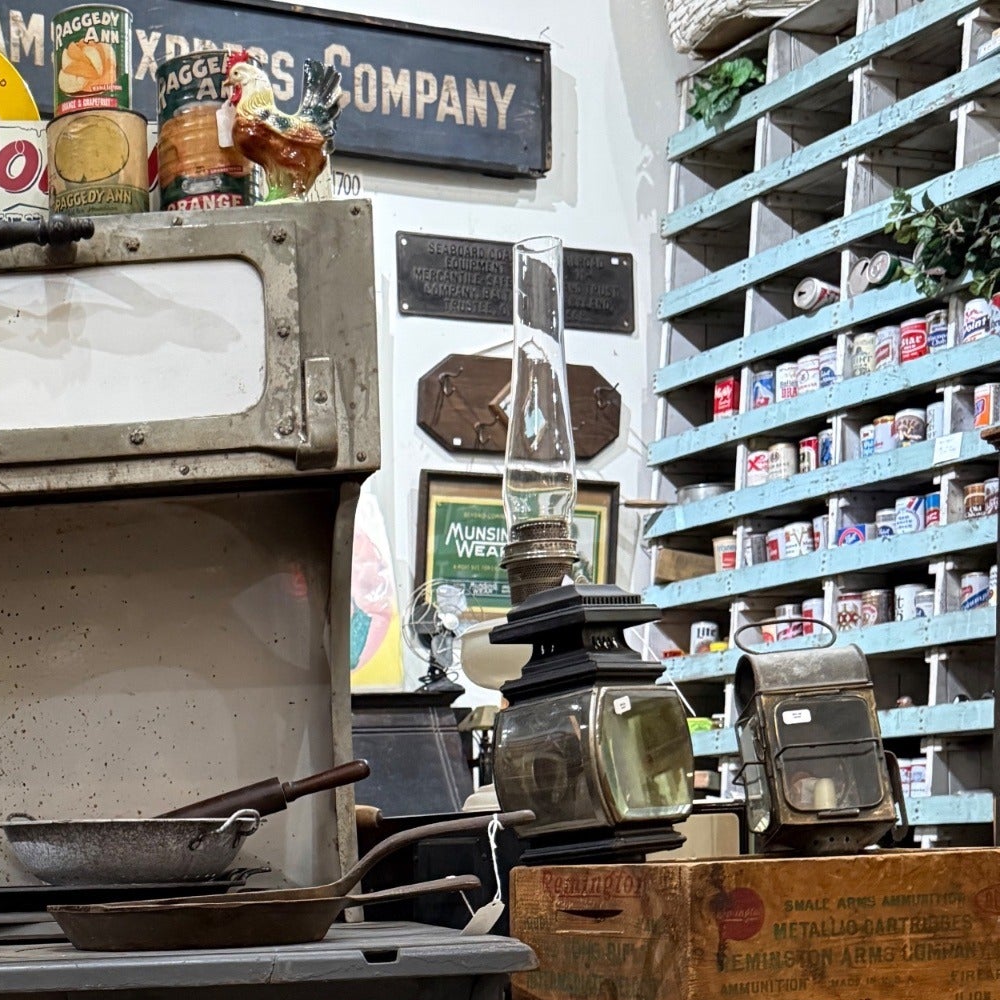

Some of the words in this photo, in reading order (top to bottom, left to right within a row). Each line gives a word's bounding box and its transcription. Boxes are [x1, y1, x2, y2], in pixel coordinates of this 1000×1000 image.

[56, 12, 120, 51] RAGGEDY
[84, 27, 120, 44] ANN
[324, 43, 516, 130] COMPANY
[54, 188, 105, 212] RAGGEDY
[105, 188, 132, 204] ANN
[429, 242, 487, 260] SEABOARD
[784, 897, 829, 912] SMALL
[837, 895, 876, 910] ARMS
[882, 892, 966, 907] AMMUNITION
[864, 914, 973, 938] CARTRIDGES
[840, 947, 896, 968] ARMS
[720, 979, 809, 997] AMMUNITION
